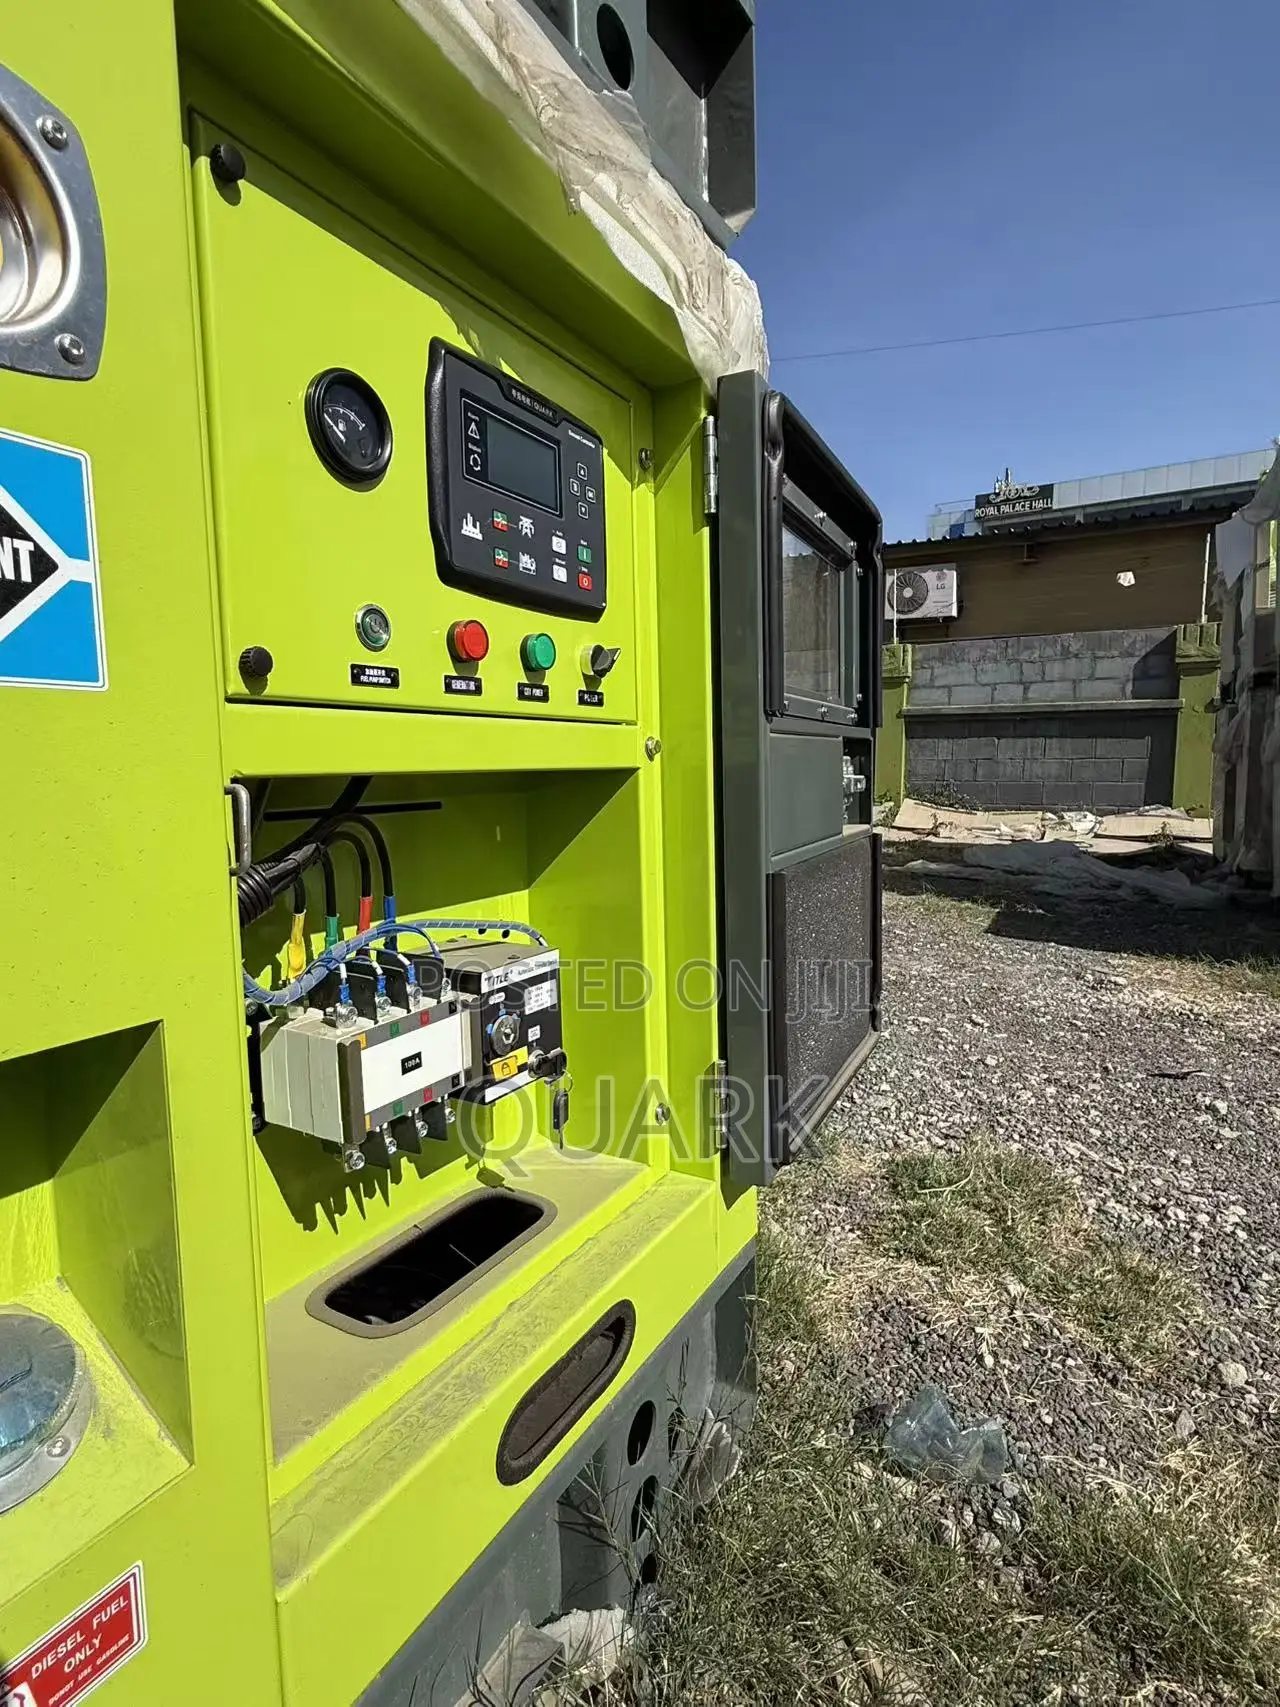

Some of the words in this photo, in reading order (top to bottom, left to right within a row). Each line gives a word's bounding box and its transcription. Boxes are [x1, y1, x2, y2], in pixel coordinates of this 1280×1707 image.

[975, 506, 999, 518] ROYAL
[1000, 501, 1030, 514] PALACE
[1031, 498, 1053, 510] HALL
[404, 1057, 420, 1069] 100A
[31, 1630, 86, 1680] DIESEL
[92, 1595, 129, 1630] FUEL
[63, 1633, 102, 1673] ONLY
[78, 1665, 93, 1681] USE
[96, 1633, 130, 1665] GASOLINE
